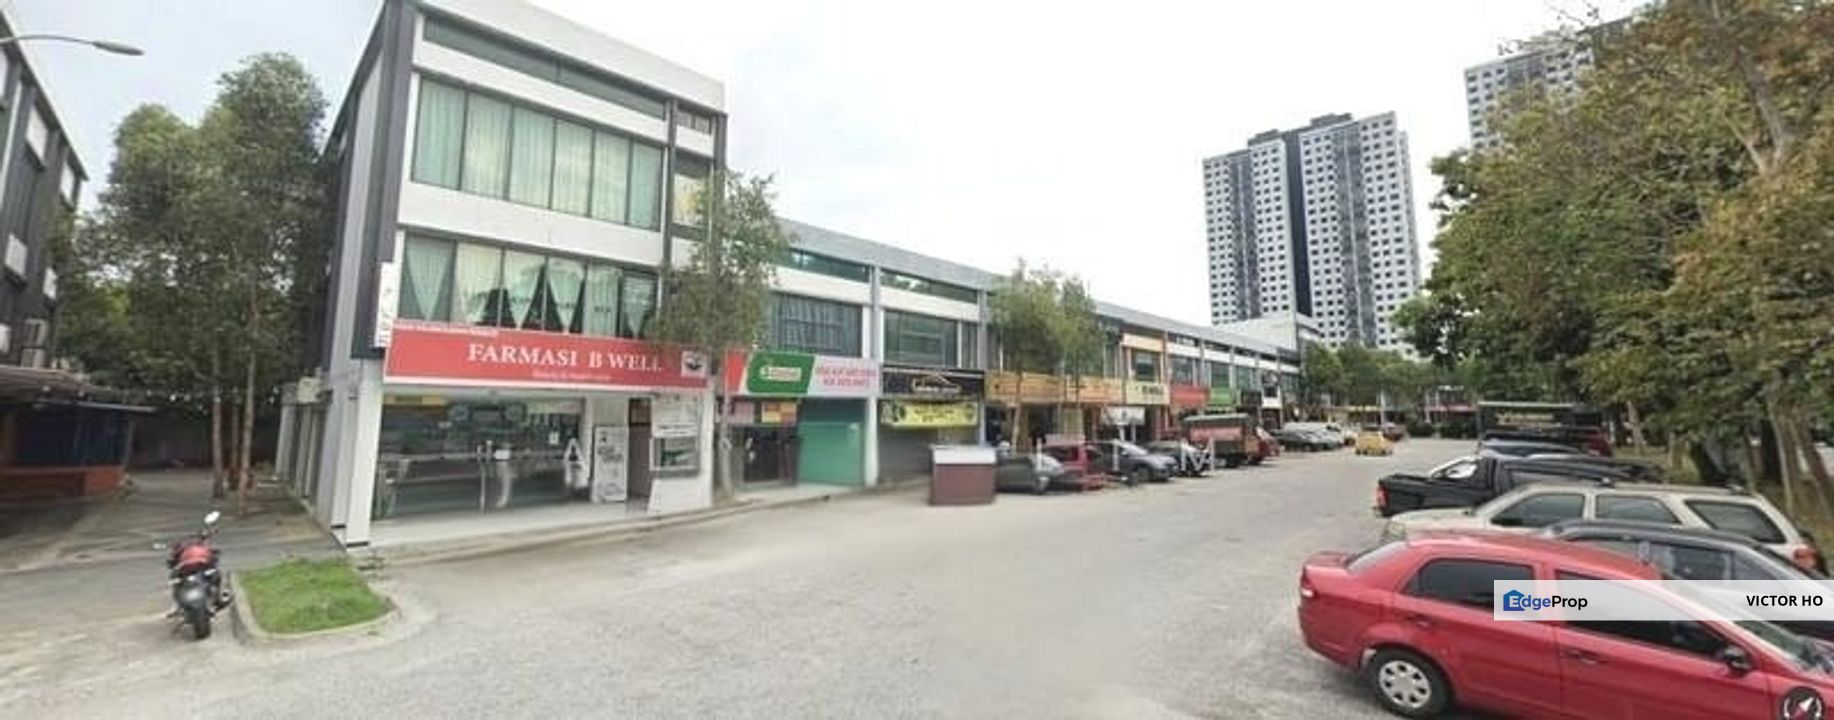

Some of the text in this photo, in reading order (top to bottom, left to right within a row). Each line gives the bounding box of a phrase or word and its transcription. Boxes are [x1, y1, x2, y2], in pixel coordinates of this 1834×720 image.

[468, 343, 663, 373] FARMASI B WELL
